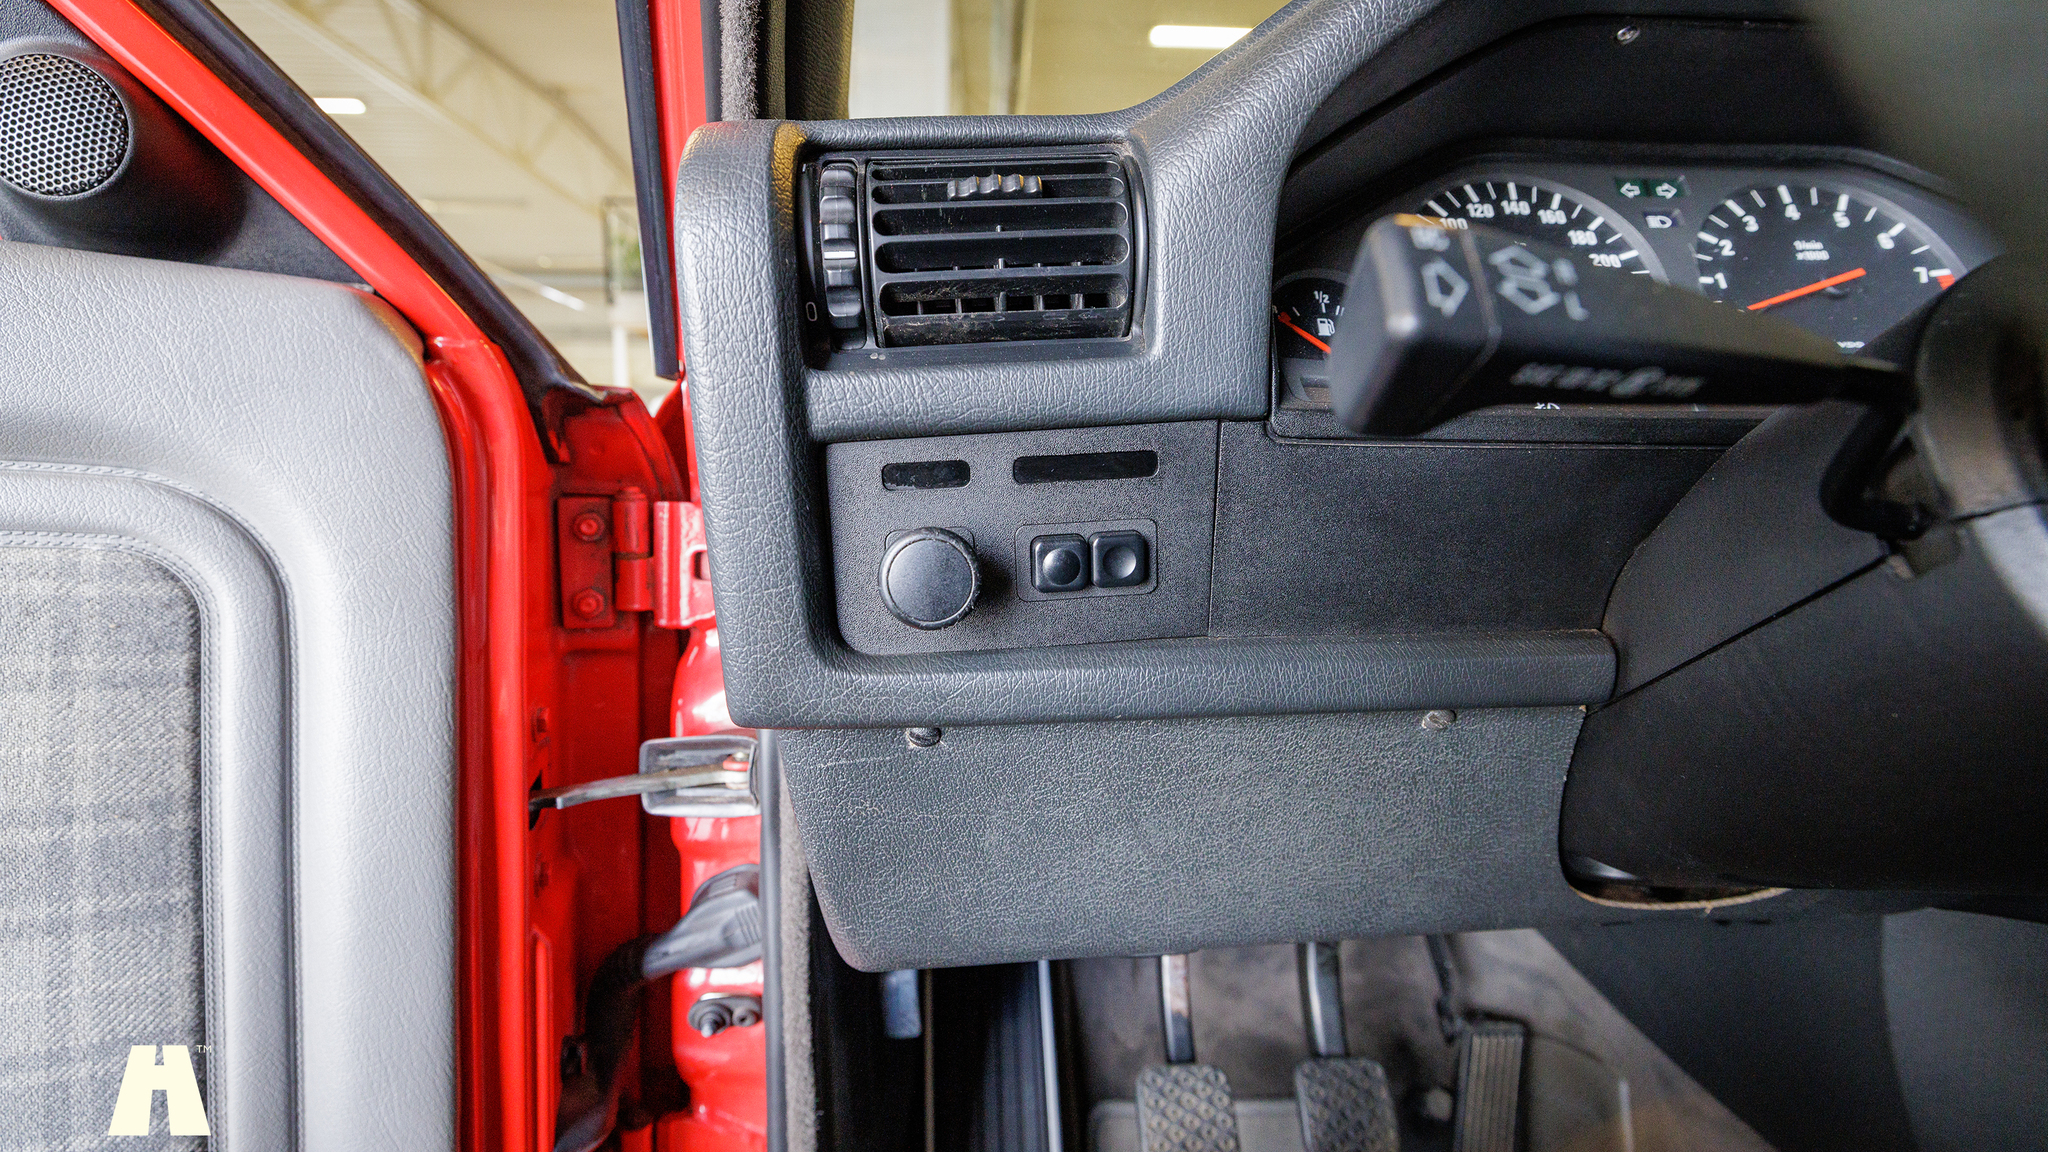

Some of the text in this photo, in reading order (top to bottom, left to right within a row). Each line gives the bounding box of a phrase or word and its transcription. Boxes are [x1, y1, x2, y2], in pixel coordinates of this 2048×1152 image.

[1465, 202, 1495, 219] 120
[1500, 200, 1531, 216] 140
[1537, 208, 1567, 225] 160
[1784, 203, 1801, 221] 4
[1439, 217, 1469, 230] 100
[1741, 214, 1759, 233] 3
[1832, 211, 1851, 229] 5
[1567, 229, 1598, 246] 180
[1876, 232, 1895, 250] 6
[1717, 238, 1736, 257] 2
[1588, 253, 1622, 268] 200
[1714, 272, 1728, 289] 1
[1912, 266, 1929, 284] 7
